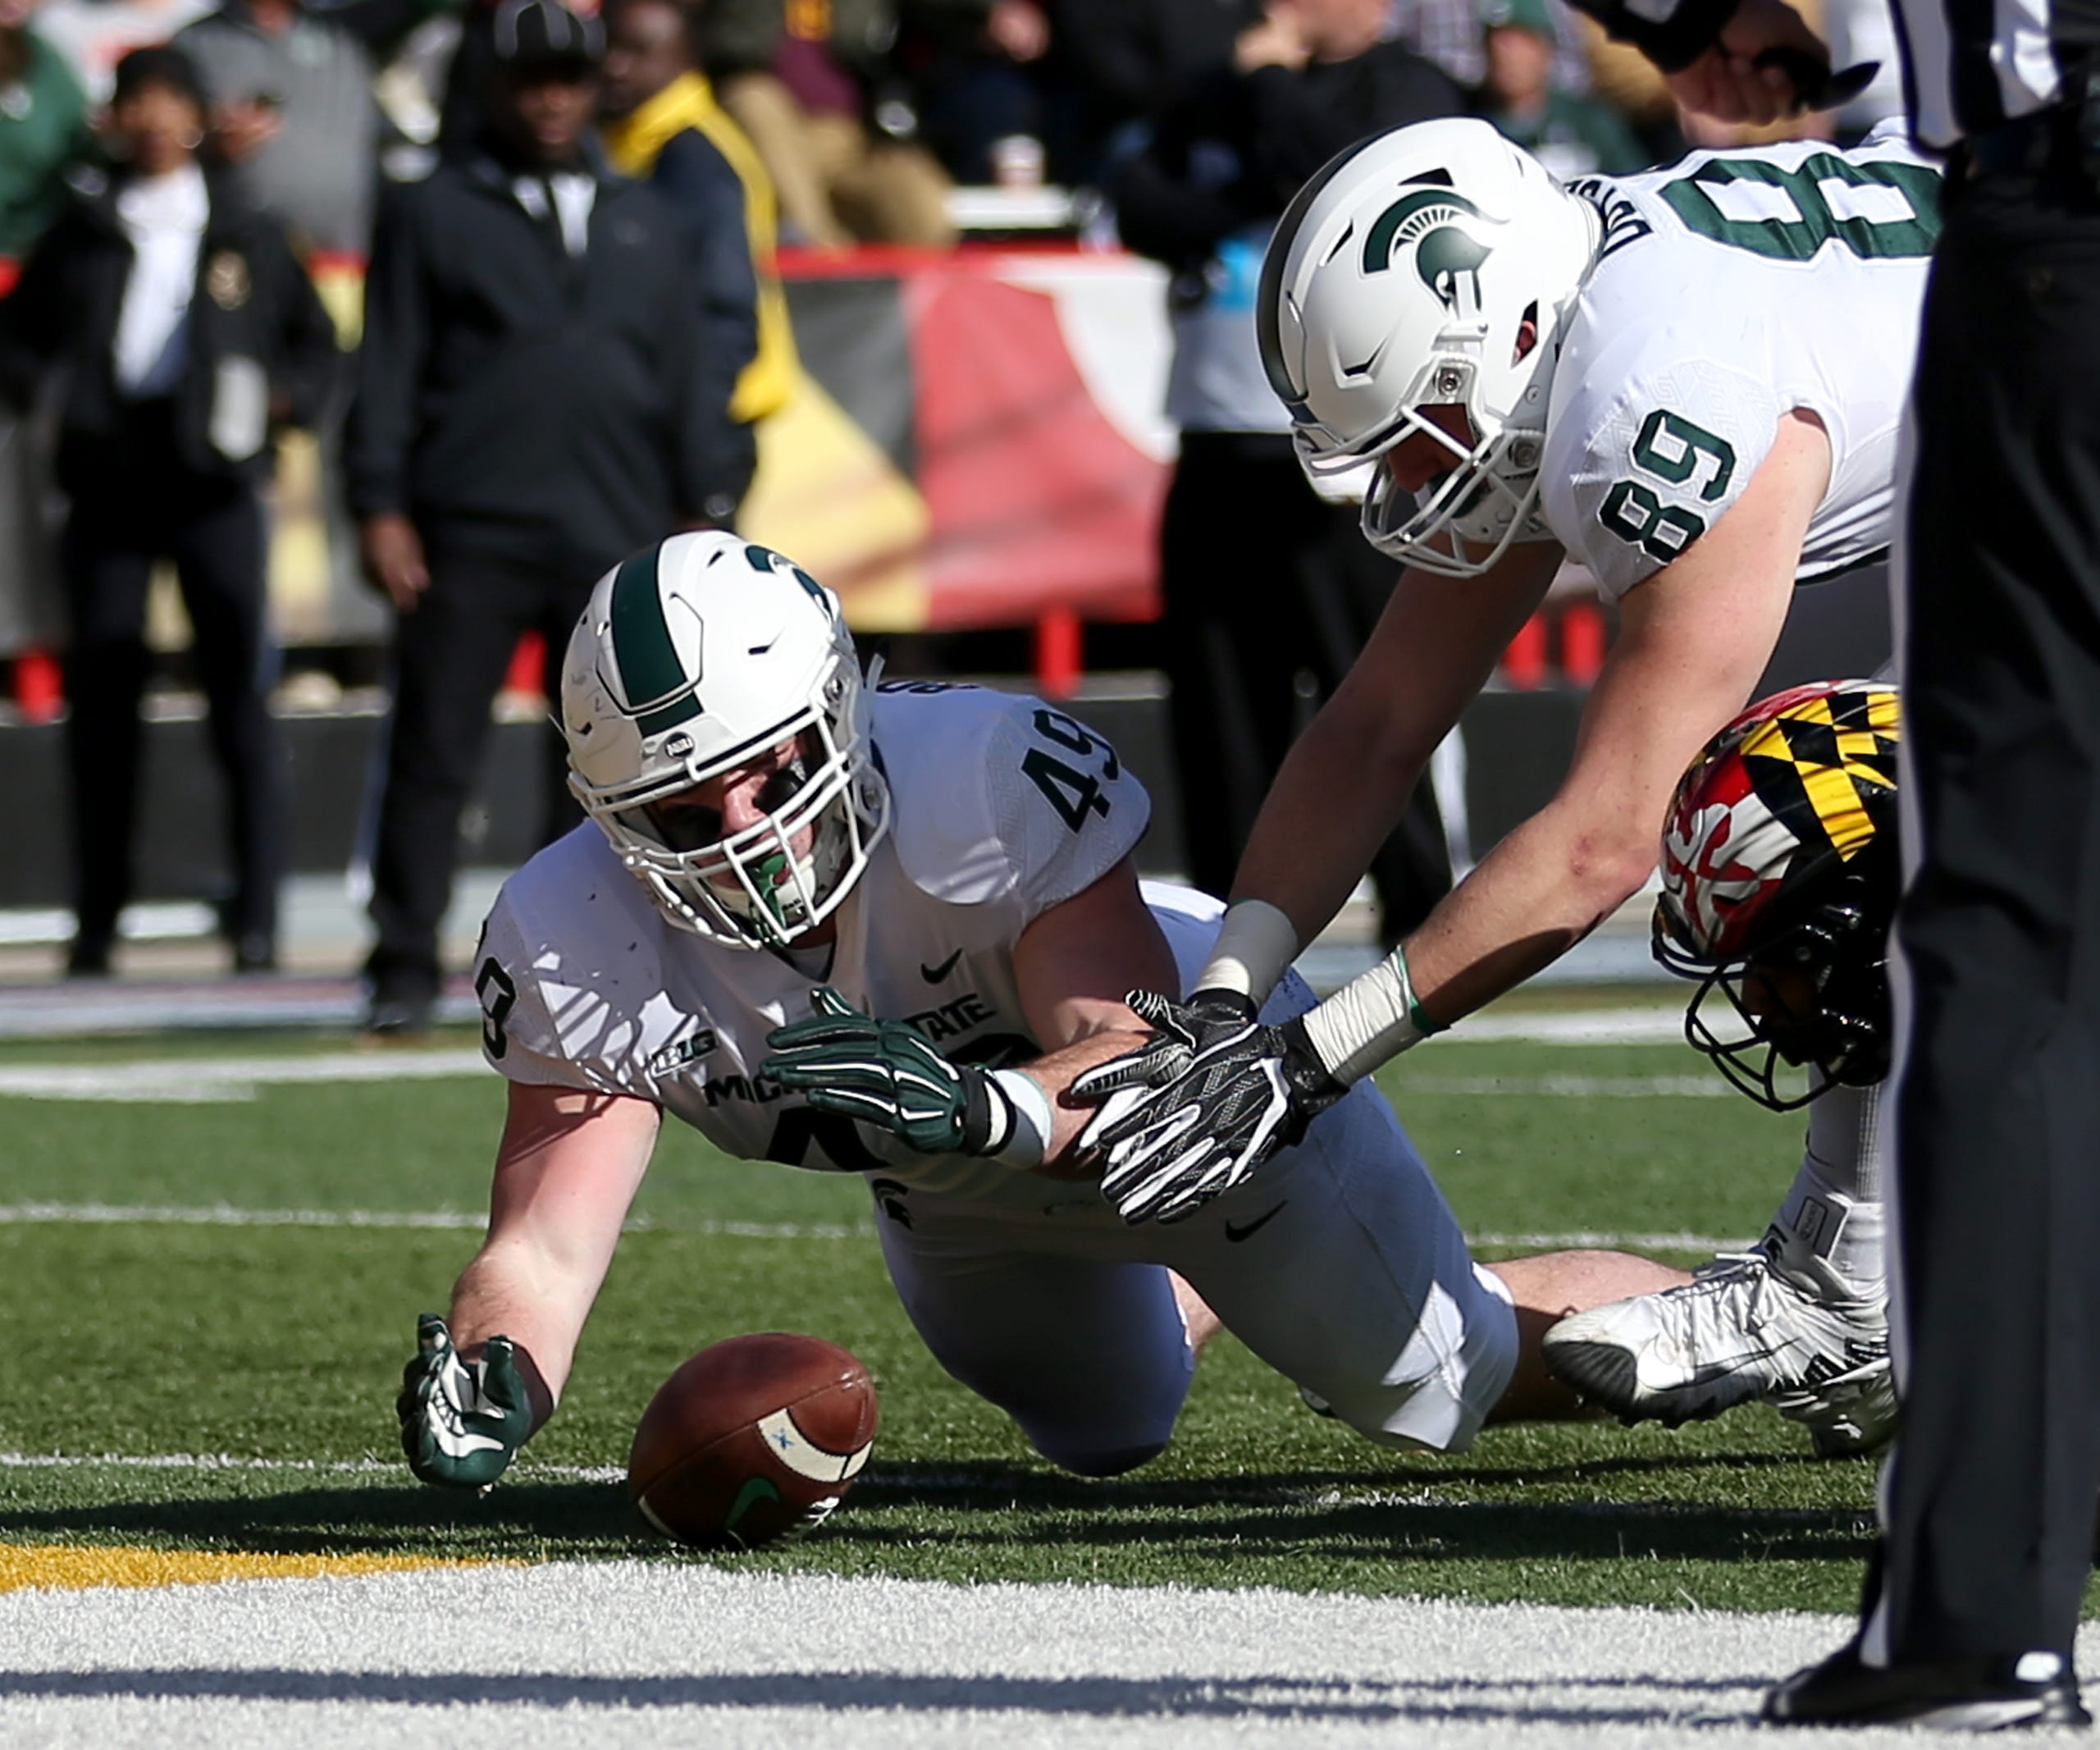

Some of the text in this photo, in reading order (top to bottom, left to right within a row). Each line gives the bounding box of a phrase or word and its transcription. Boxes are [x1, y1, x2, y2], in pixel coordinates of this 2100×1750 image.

[1600, 409, 1736, 564] 89
[1020, 709, 1119, 834] 49
[902, 993, 998, 1042] TATE
